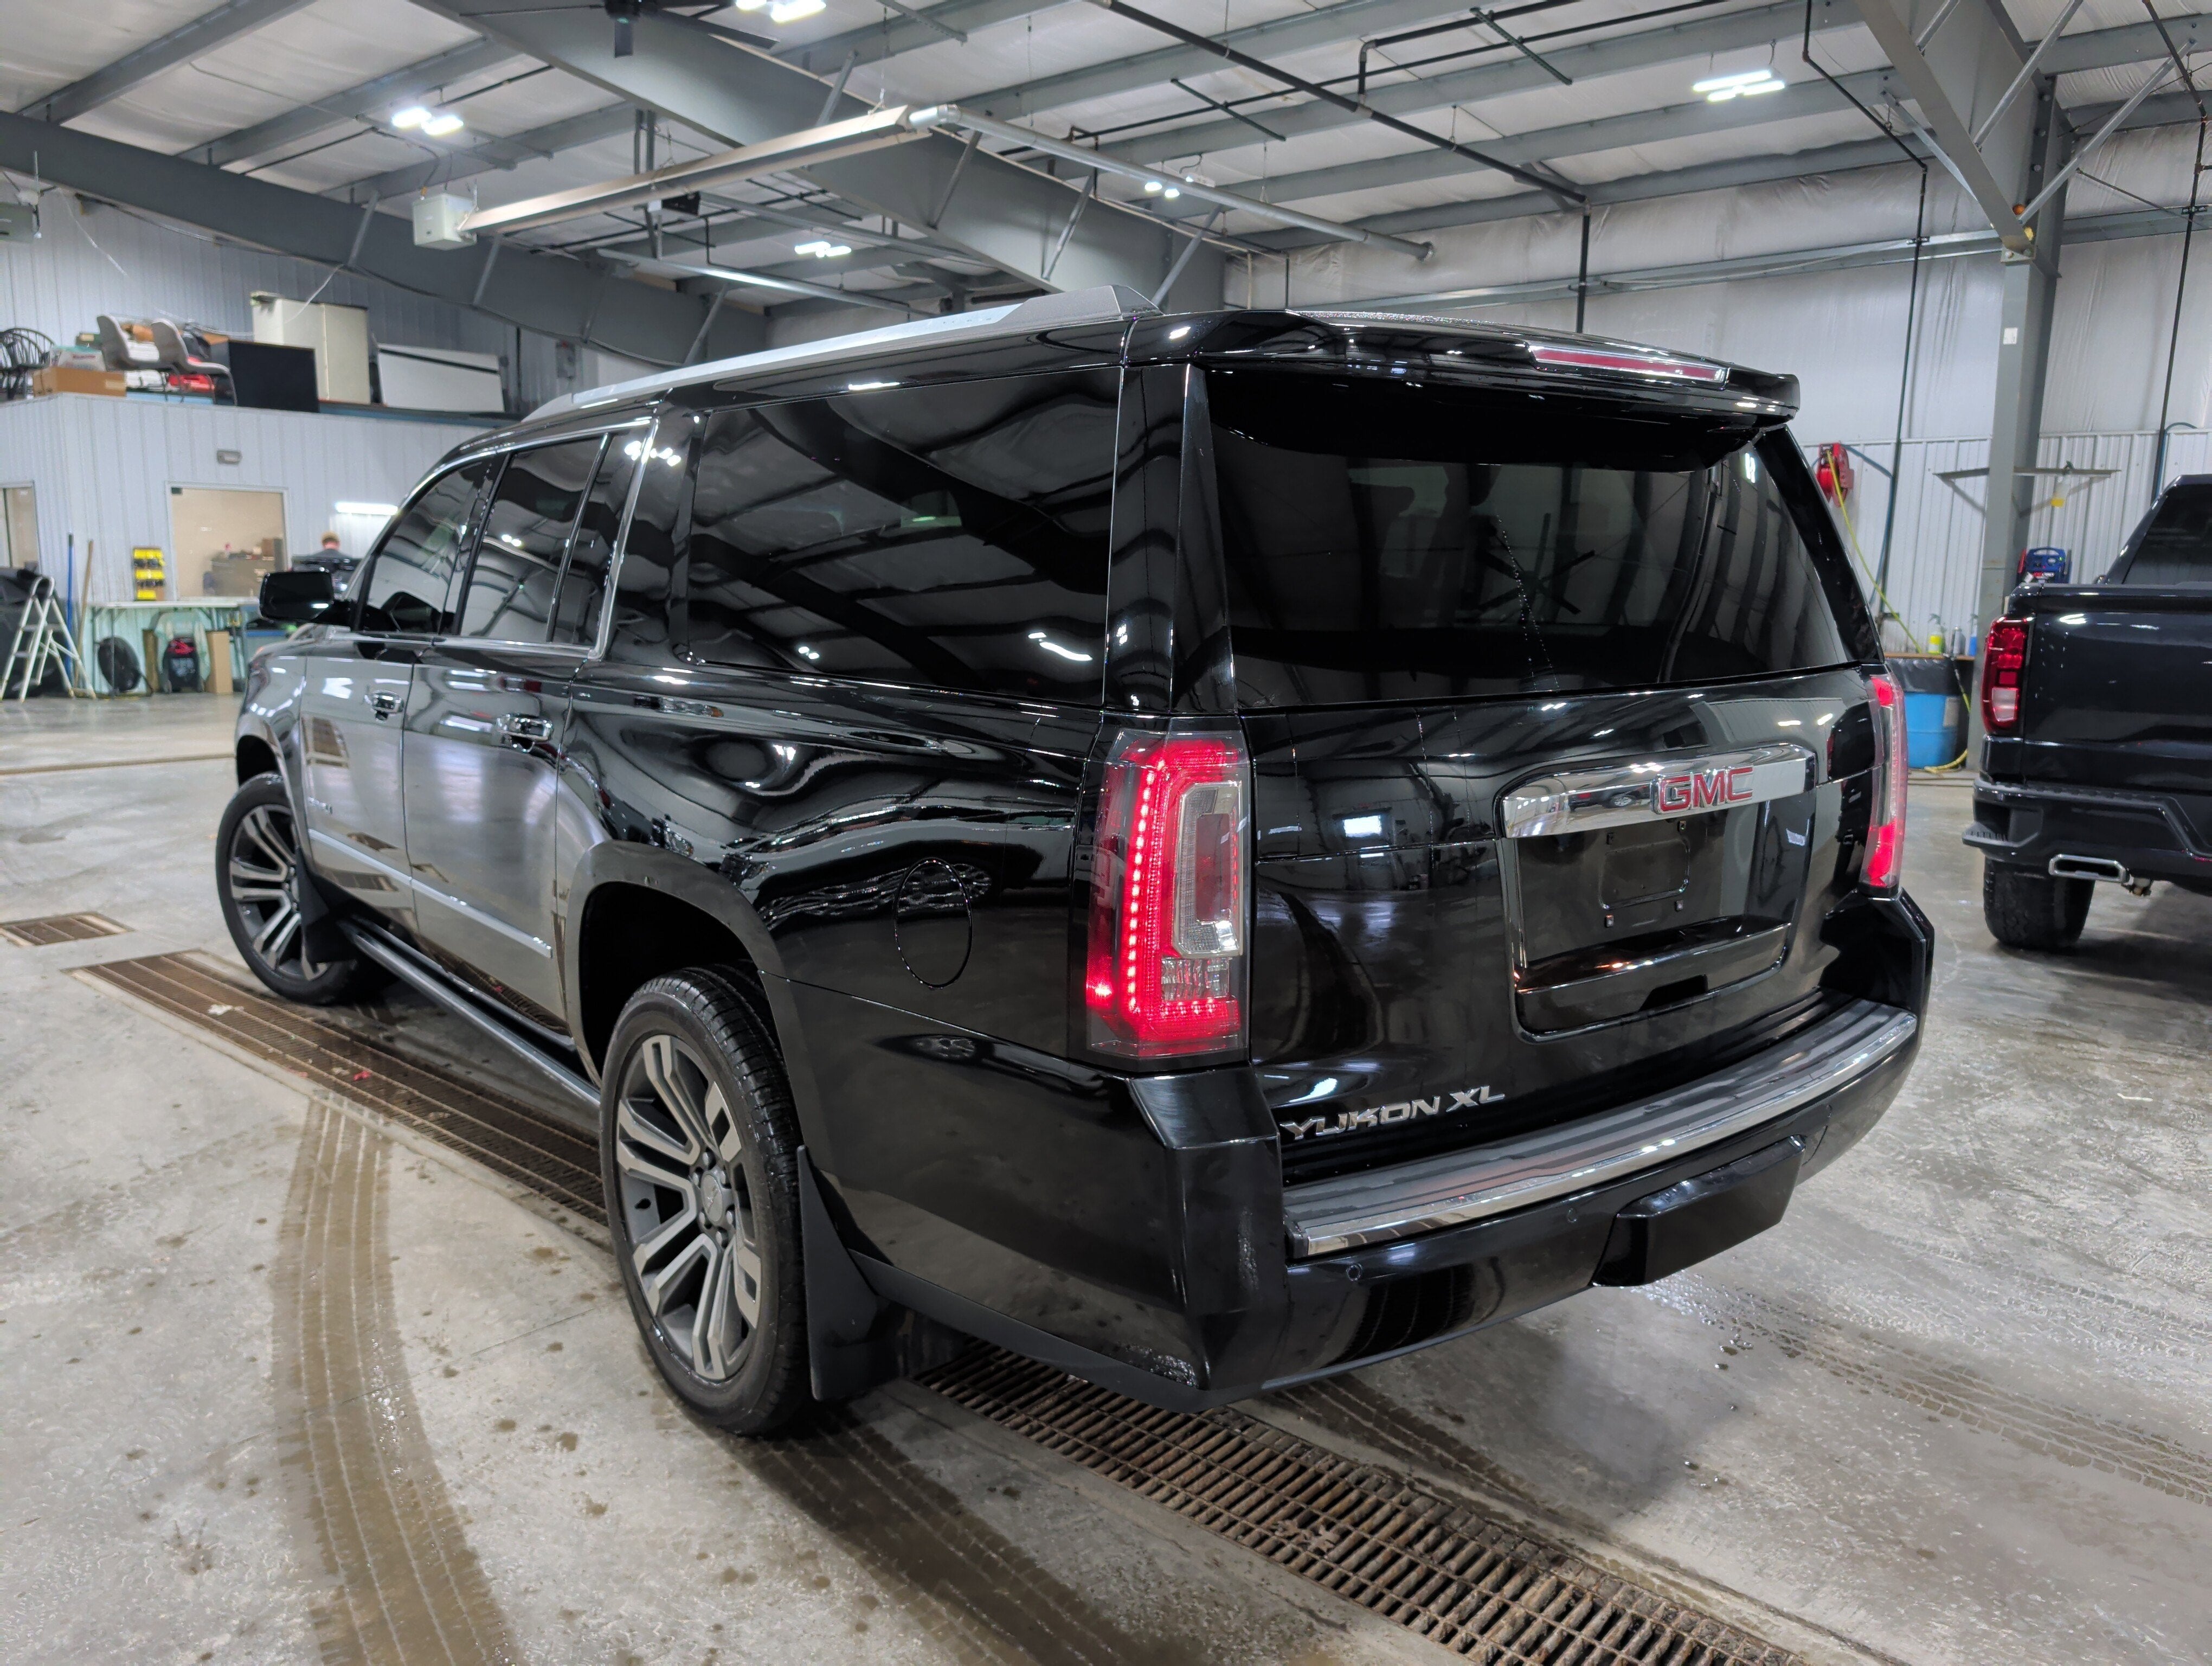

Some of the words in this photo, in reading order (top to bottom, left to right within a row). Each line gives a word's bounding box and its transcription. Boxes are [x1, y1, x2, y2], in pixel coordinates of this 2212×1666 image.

[1653, 765, 1754, 813] GMC
[1280, 1095, 1441, 1140] YUKON
[1446, 1085, 1506, 1112] XL
